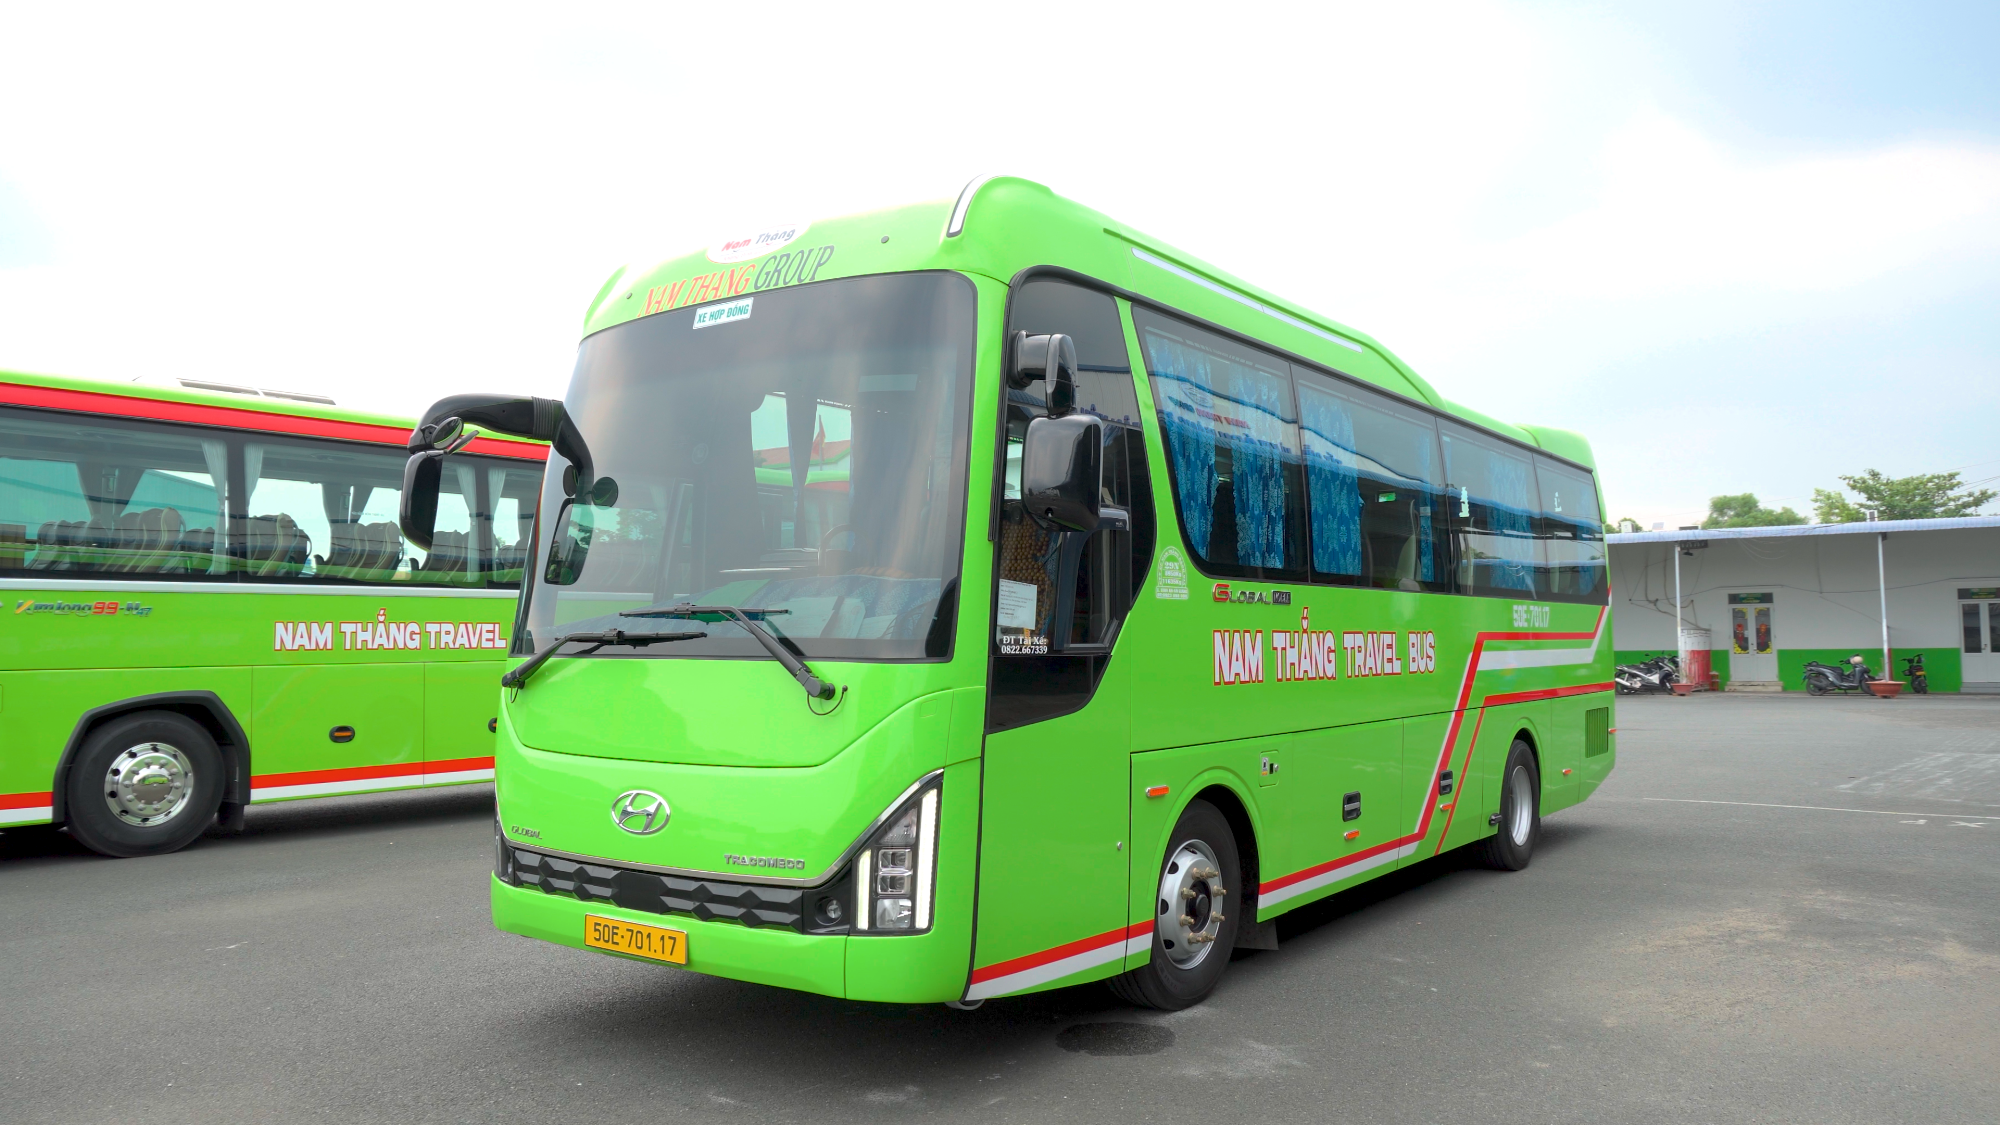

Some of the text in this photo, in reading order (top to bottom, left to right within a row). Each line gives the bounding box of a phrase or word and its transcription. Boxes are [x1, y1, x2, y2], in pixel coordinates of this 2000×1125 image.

[721, 238, 752, 252] Nam
[637, 244, 835, 318] NAM THANG GROUP
[697, 312, 708, 324] XE
[274, 608, 507, 650] NAM THẮNG TRAVEL
[1001, 645, 1048, 654] 0822.667339
[1213, 606, 1436, 686] NAM THẮNG TRAVEL BUS
[511, 825, 543, 840] GLOBAL
